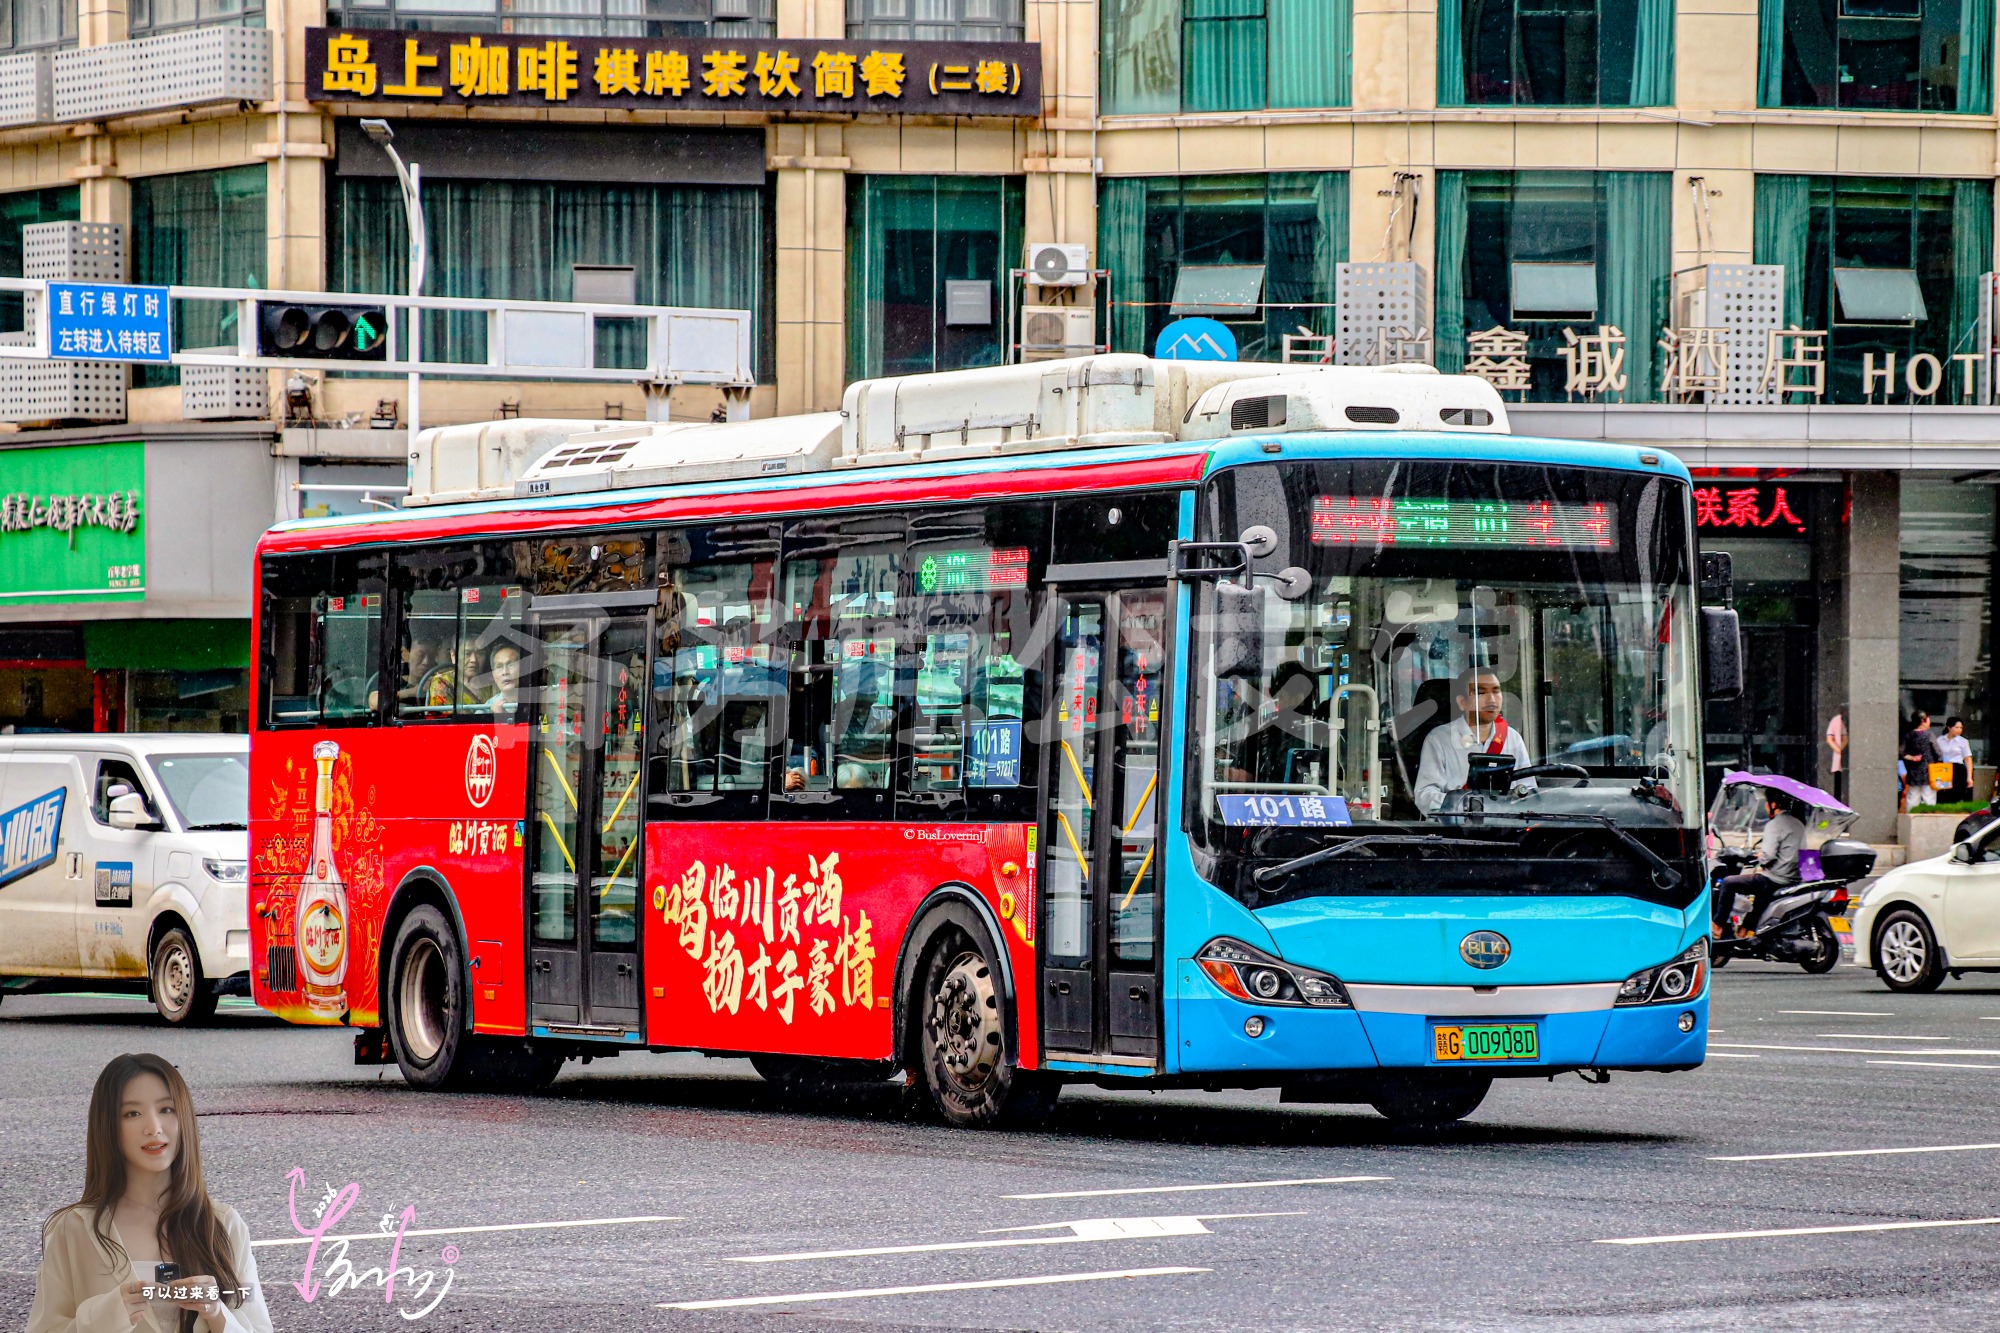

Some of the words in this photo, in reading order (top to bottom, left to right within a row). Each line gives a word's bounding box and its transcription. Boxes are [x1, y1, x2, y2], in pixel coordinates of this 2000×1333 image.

[322, 33, 579, 101] 岛上咖啡
[593, 48, 692, 97] 棋牌
[701, 50, 801, 98] 茶饮
[811, 50, 907, 99] 简餐
[58, 289, 160, 318] 直行绿灯时
[58, 327, 162, 355] 左转进入待转区
[1134, 653, 1149, 733] 小心开门
[973, 727, 1011, 755] 101路
[1244, 796, 1327, 819] 101路
[664, 851, 843, 960] 喝临川贡酒
[1468, 941, 1502, 956] BLK
